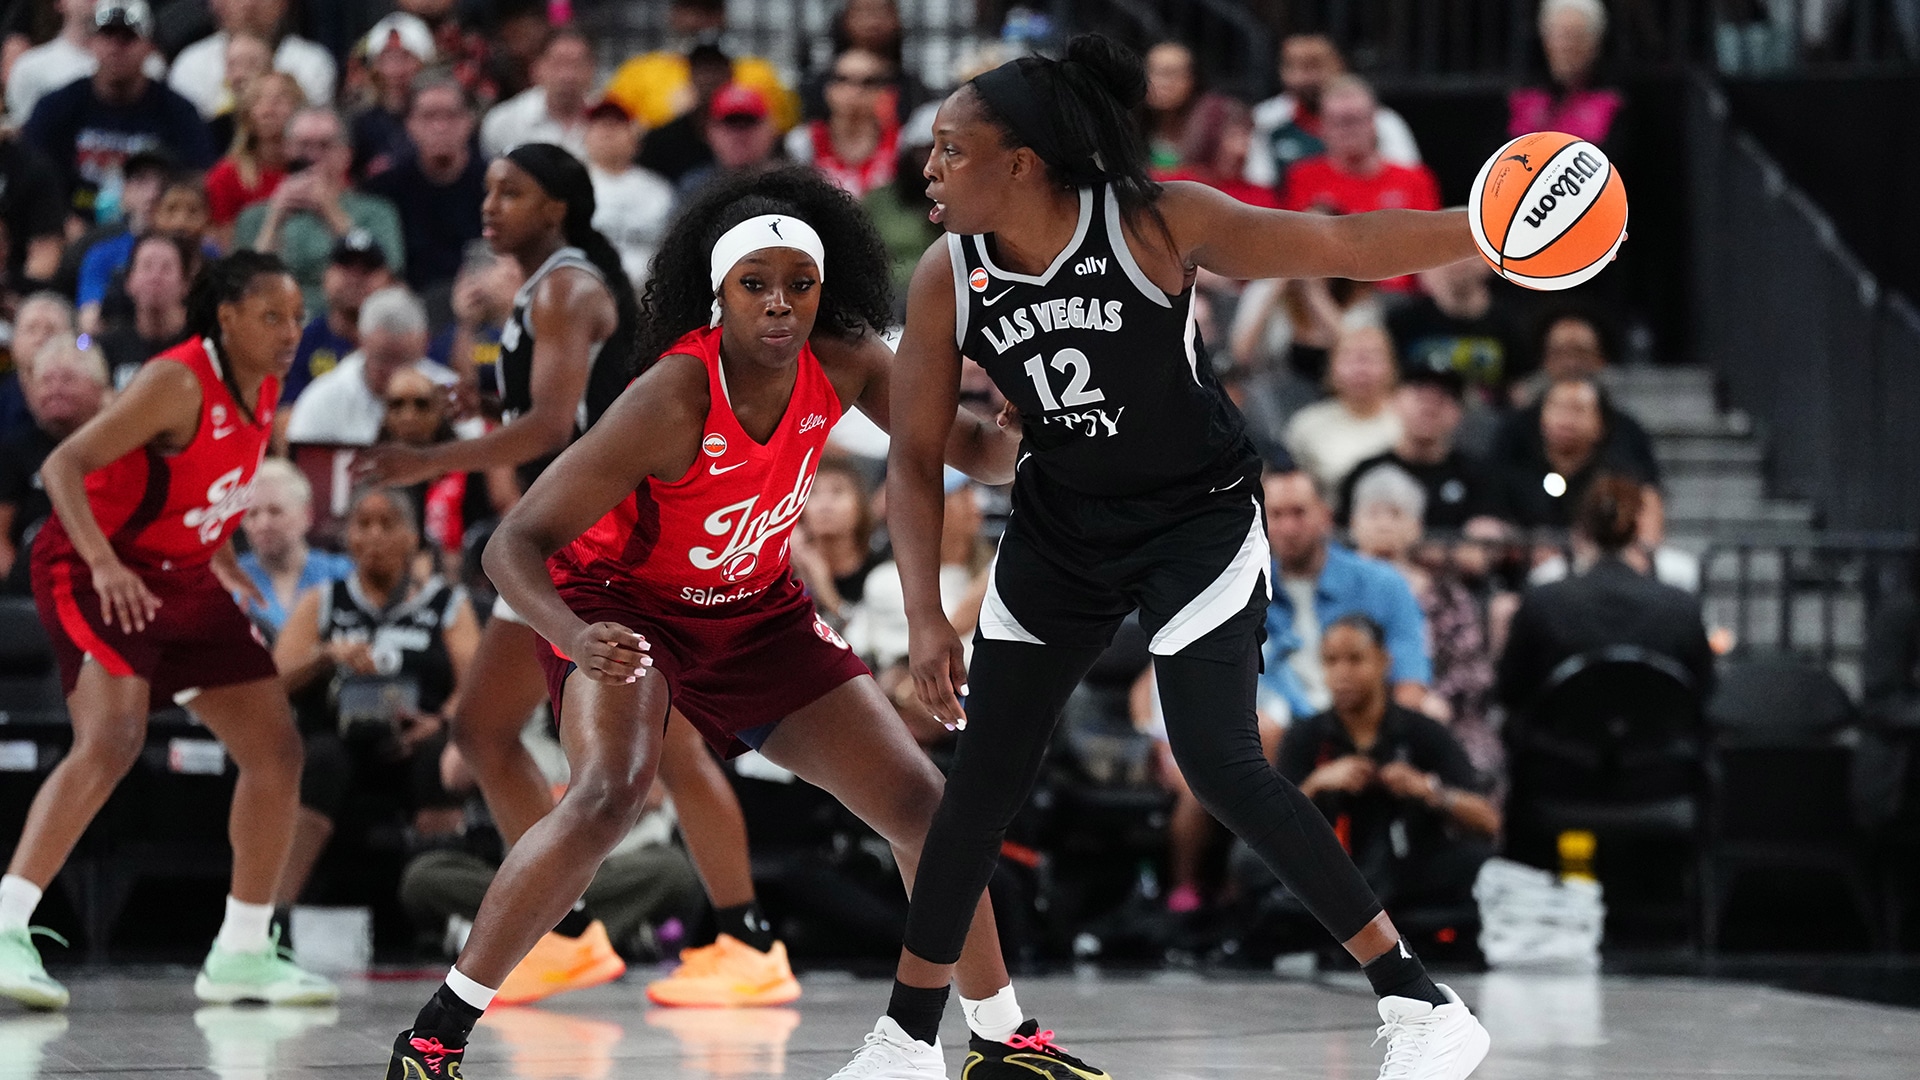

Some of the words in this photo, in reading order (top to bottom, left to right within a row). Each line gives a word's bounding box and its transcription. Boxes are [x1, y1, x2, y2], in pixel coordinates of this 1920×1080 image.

[1523, 151, 1603, 229] Wilson
[1074, 256, 1107, 276] ally
[980, 307, 1036, 356] LAS
[1030, 296, 1124, 333] VEGAS
[1023, 347, 1106, 412] 12
[798, 413, 828, 434] Lilly
